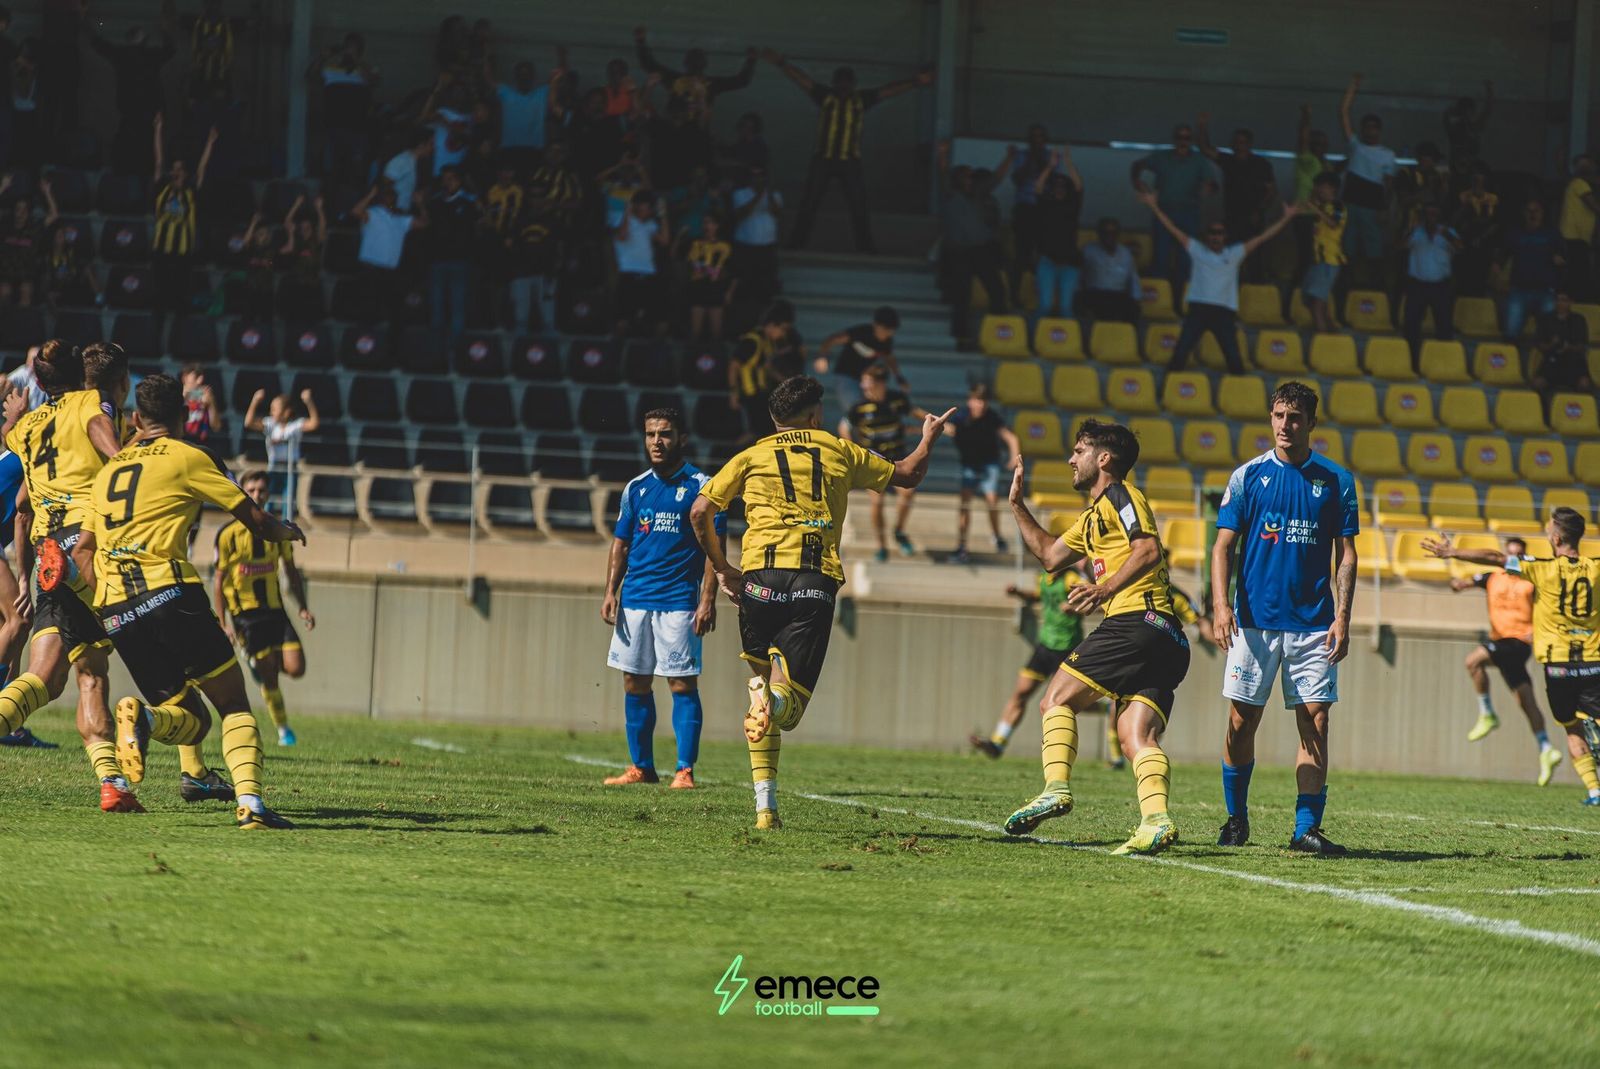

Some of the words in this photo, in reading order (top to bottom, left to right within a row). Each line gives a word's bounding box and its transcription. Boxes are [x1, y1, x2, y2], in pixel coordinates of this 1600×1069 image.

[774, 445, 823, 503] 17
[104, 463, 143, 531] 9
[1287, 520, 1319, 529] MELILLA
[1287, 527, 1313, 536] SPORT
[1285, 535, 1317, 545] CAPITAL
[119, 610, 135, 624] LAS
[135, 586, 182, 617] PALMERITAS
[771, 591, 788, 602] LAS
[1559, 576, 1593, 618] 10
